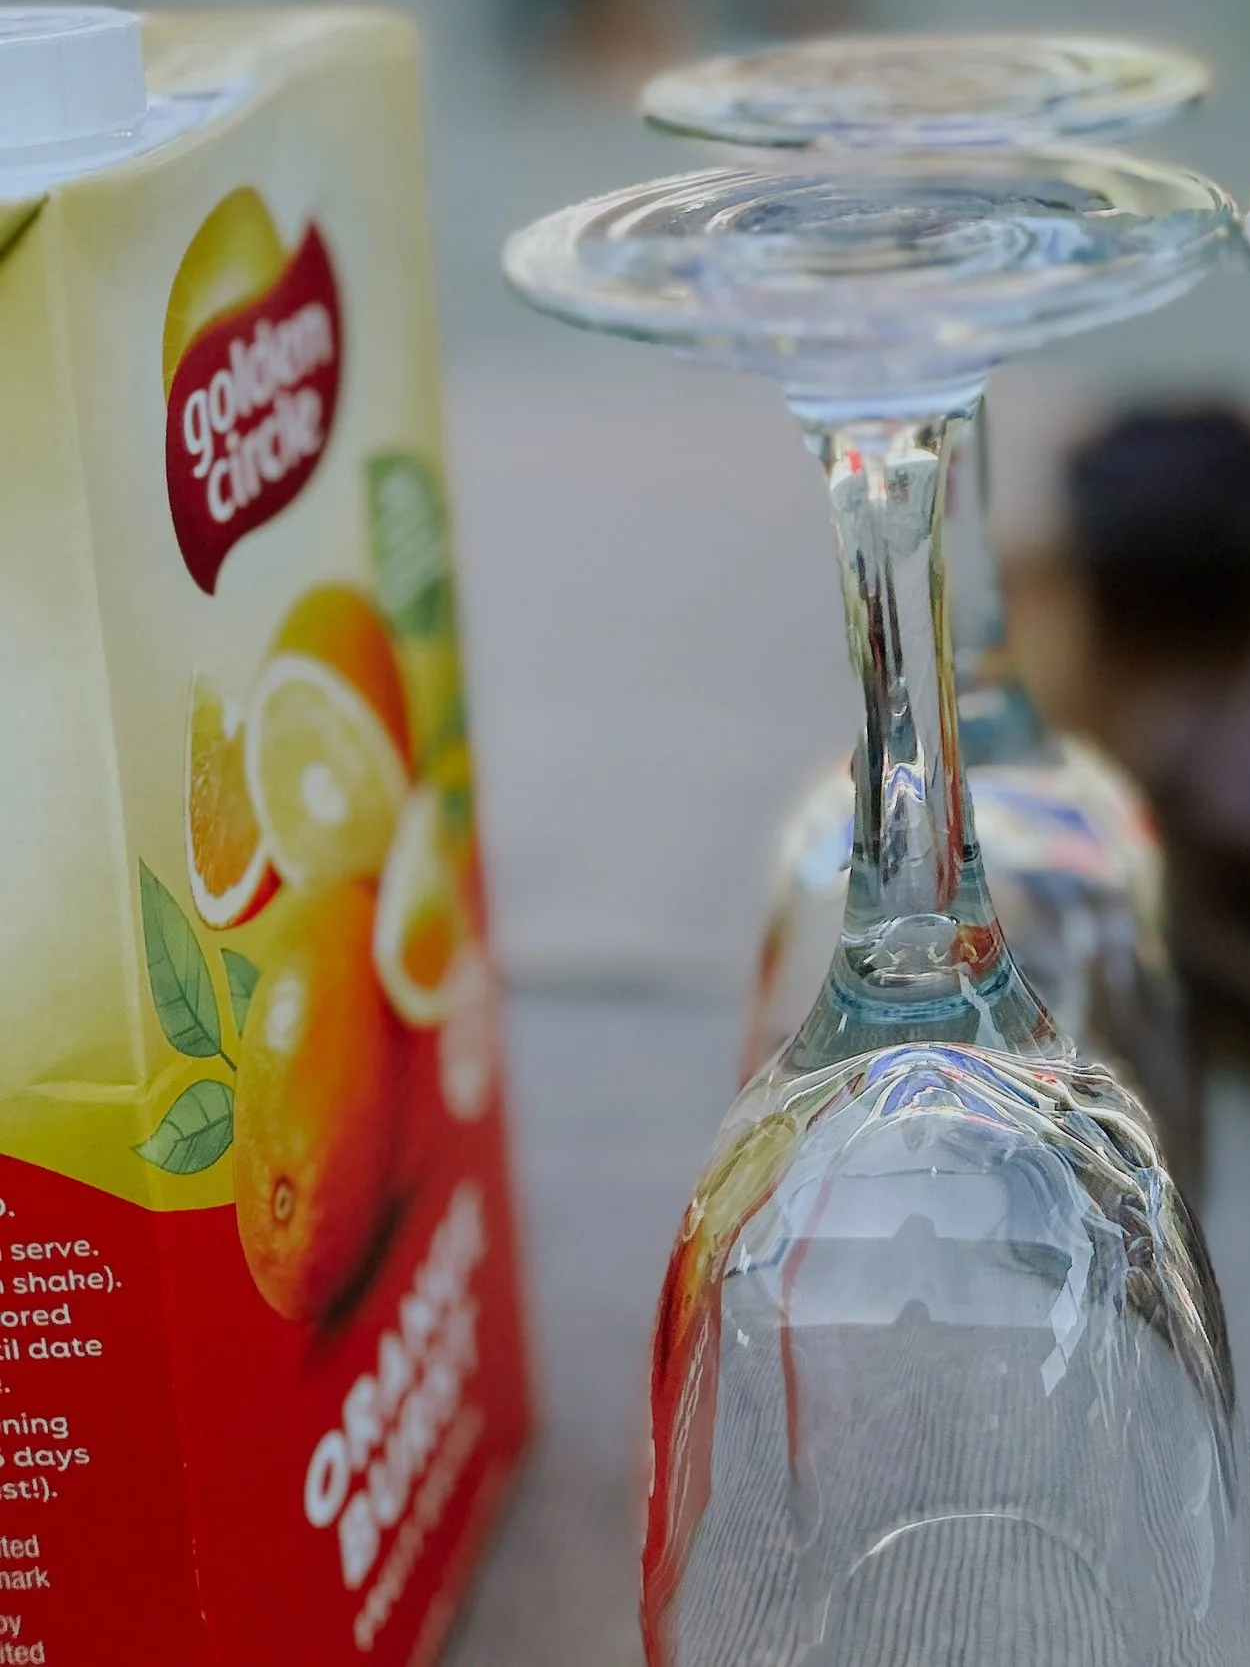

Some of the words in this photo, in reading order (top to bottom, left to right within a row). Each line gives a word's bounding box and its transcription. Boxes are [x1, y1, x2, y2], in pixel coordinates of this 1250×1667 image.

[183, 299, 335, 479] golden
[207, 387, 325, 525] circle
[10, 1238, 100, 1262] serve.
[12, 1264, 123, 1295] shake).
[0, 1302, 72, 1328] ored
[0, 1336, 20, 1361] il
[28, 1337, 103, 1360] date
[2, 1412, 69, 1440] ning
[13, 1445, 91, 1472] days
[0, 1475, 58, 1503] st!).
[0, 1533, 41, 1560] ted
